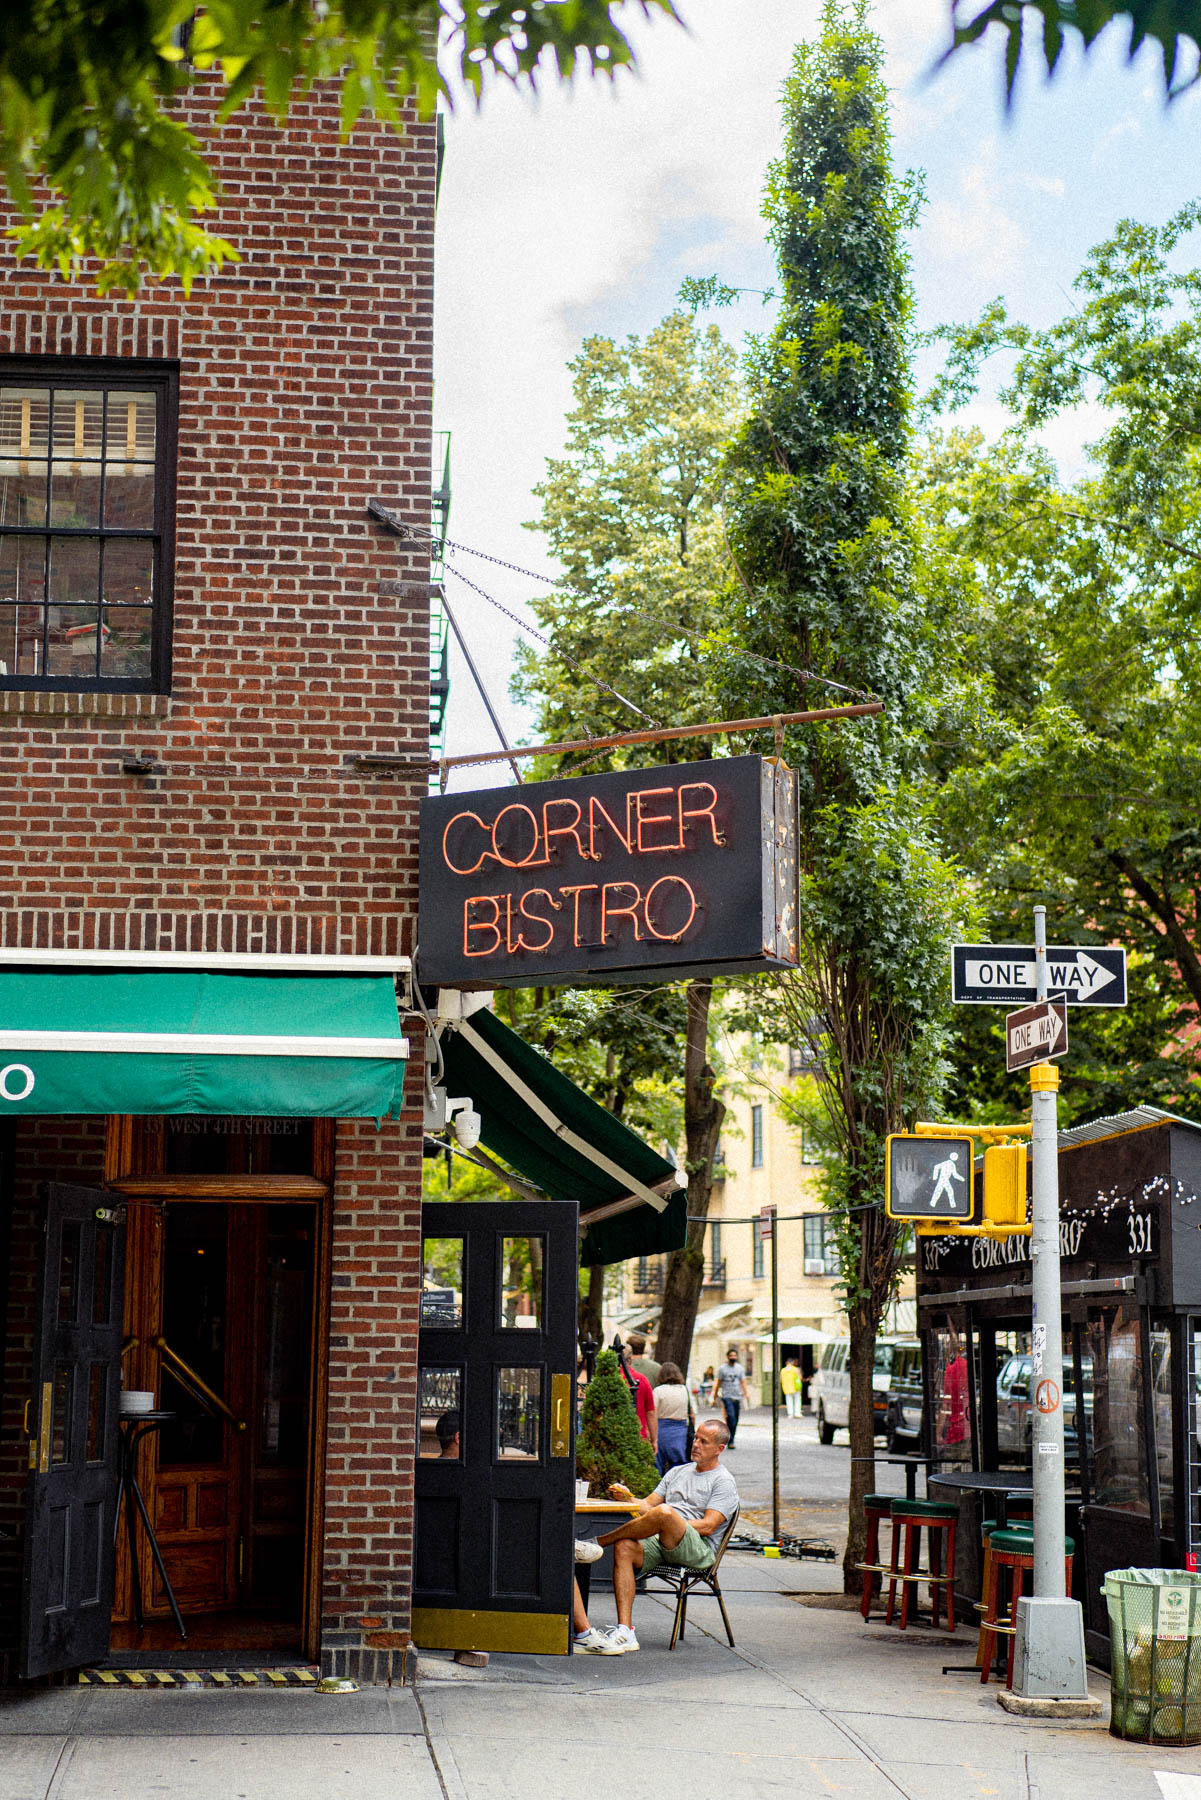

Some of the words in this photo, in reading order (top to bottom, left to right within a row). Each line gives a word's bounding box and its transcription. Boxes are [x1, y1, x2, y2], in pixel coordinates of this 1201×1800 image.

[443, 782, 727, 875] CORNER
[464, 875, 697, 957] BISTRO
[979, 964, 1026, 985] ONE
[1050, 966, 1098, 987] WAY
[1015, 1025, 1031, 1050] ONE
[1039, 1016, 1056, 1042] WAY
[144, 1118, 164, 1134] 331
[169, 1118, 208, 1135] WEST
[213, 1118, 241, 1135] 4TH
[244, 1118, 302, 1135] STREET
[1127, 1213, 1152, 1254] 331
